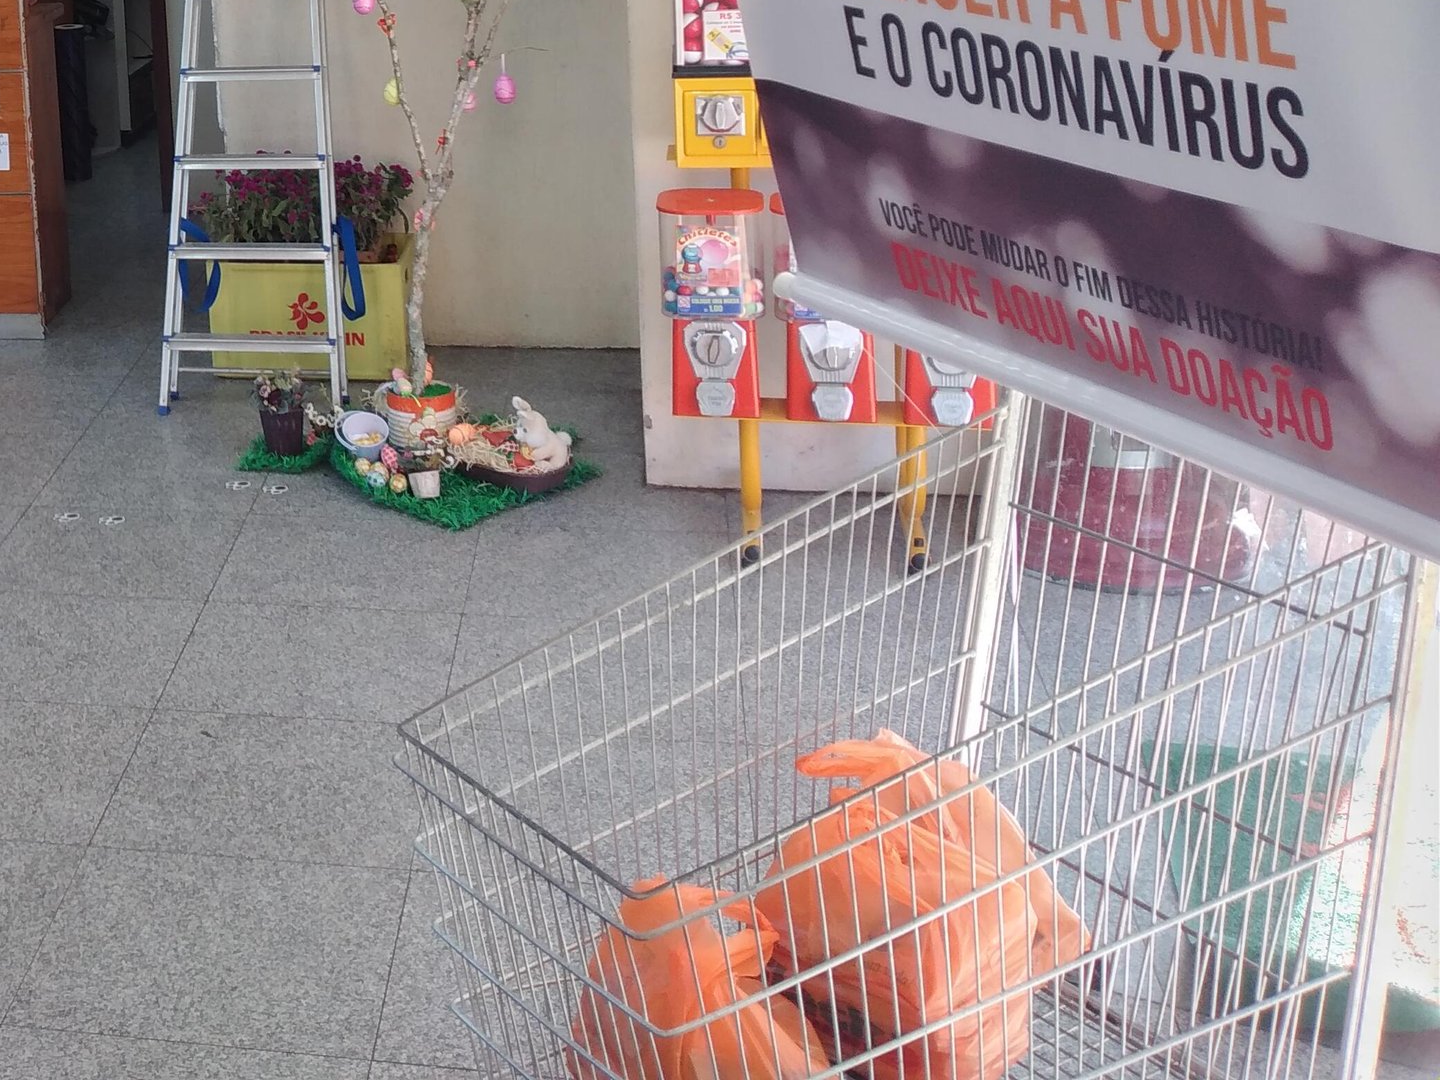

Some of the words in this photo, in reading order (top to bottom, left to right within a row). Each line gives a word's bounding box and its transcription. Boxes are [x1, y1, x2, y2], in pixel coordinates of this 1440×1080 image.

[843, 4, 877, 80] E
[880, 12, 913, 88] O
[922, 20, 1311, 180] CORONAVÍRUS
[878, 197, 927, 239] VOCÊ
[928, 213, 978, 256] PODE
[981, 231, 1051, 277] MUDAR
[1054, 253, 1070, 288] O
[1074, 262, 1113, 303] FIM
[1116, 275, 1192, 330] DESSA
[1196, 300, 1323, 371] HISTÓRIA!
[891, 241, 988, 318] DEIXE
[992, 277, 1075, 353] AQUI
[1077, 309, 1158, 384] SUA
[1161, 337, 1333, 452] DOAÇÃO
